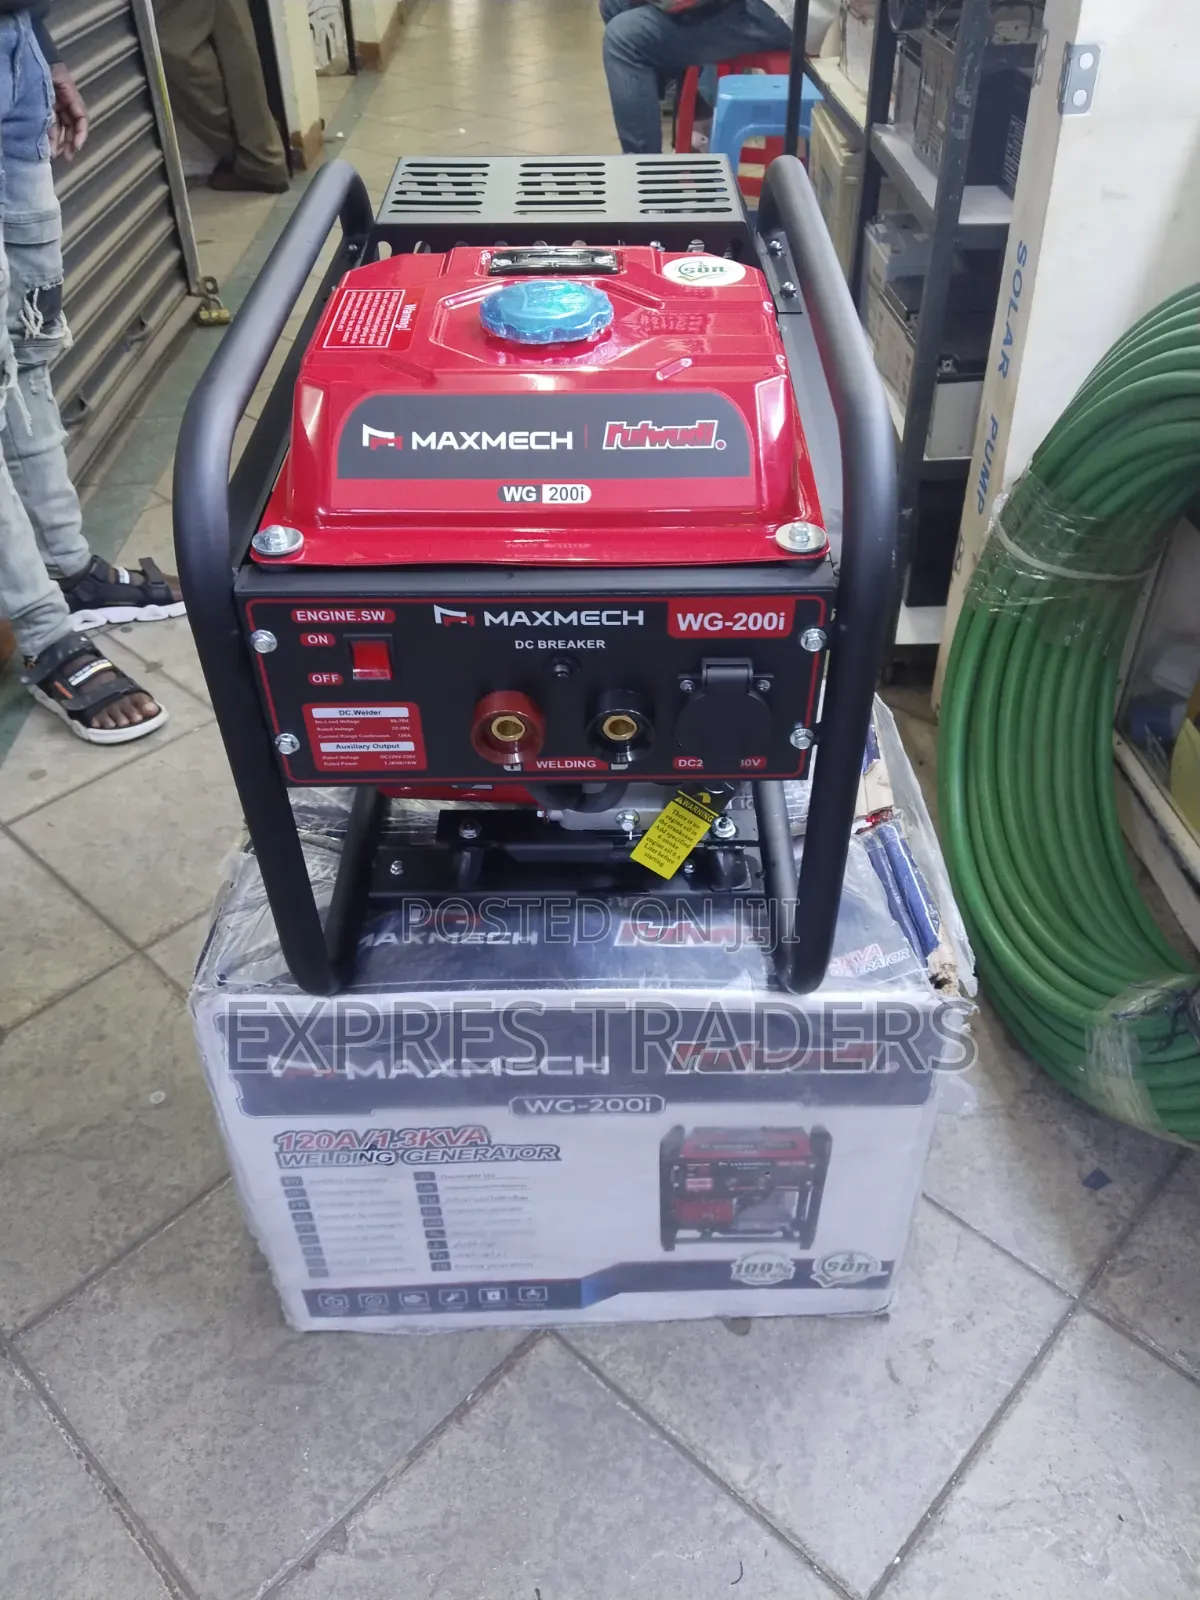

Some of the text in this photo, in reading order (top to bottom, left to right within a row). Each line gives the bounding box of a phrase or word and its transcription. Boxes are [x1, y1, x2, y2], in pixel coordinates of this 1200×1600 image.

[394, 304, 417, 331] Warning!
[976, 240, 1028, 516] SOLAR PUMP
[411, 431, 573, 450] MAXMECH
[503, 486, 585, 502] WG 200i
[296, 610, 386, 621] ENGINE.SW
[483, 610, 645, 627] MAXMECH
[676, 612, 786, 632] WG-200i
[307, 635, 329, 645] ON
[514, 639, 606, 650] DC BREAKER
[311, 674, 339, 684] OFF
[535, 759, 597, 769] WELDING
[681, 798, 715, 822] WARNING
[523, 1096, 652, 1114] WG-200i
[275, 1126, 490, 1152] 120A/1.3KVA
[278, 1145, 559, 1167] WELDING GENERATOR
